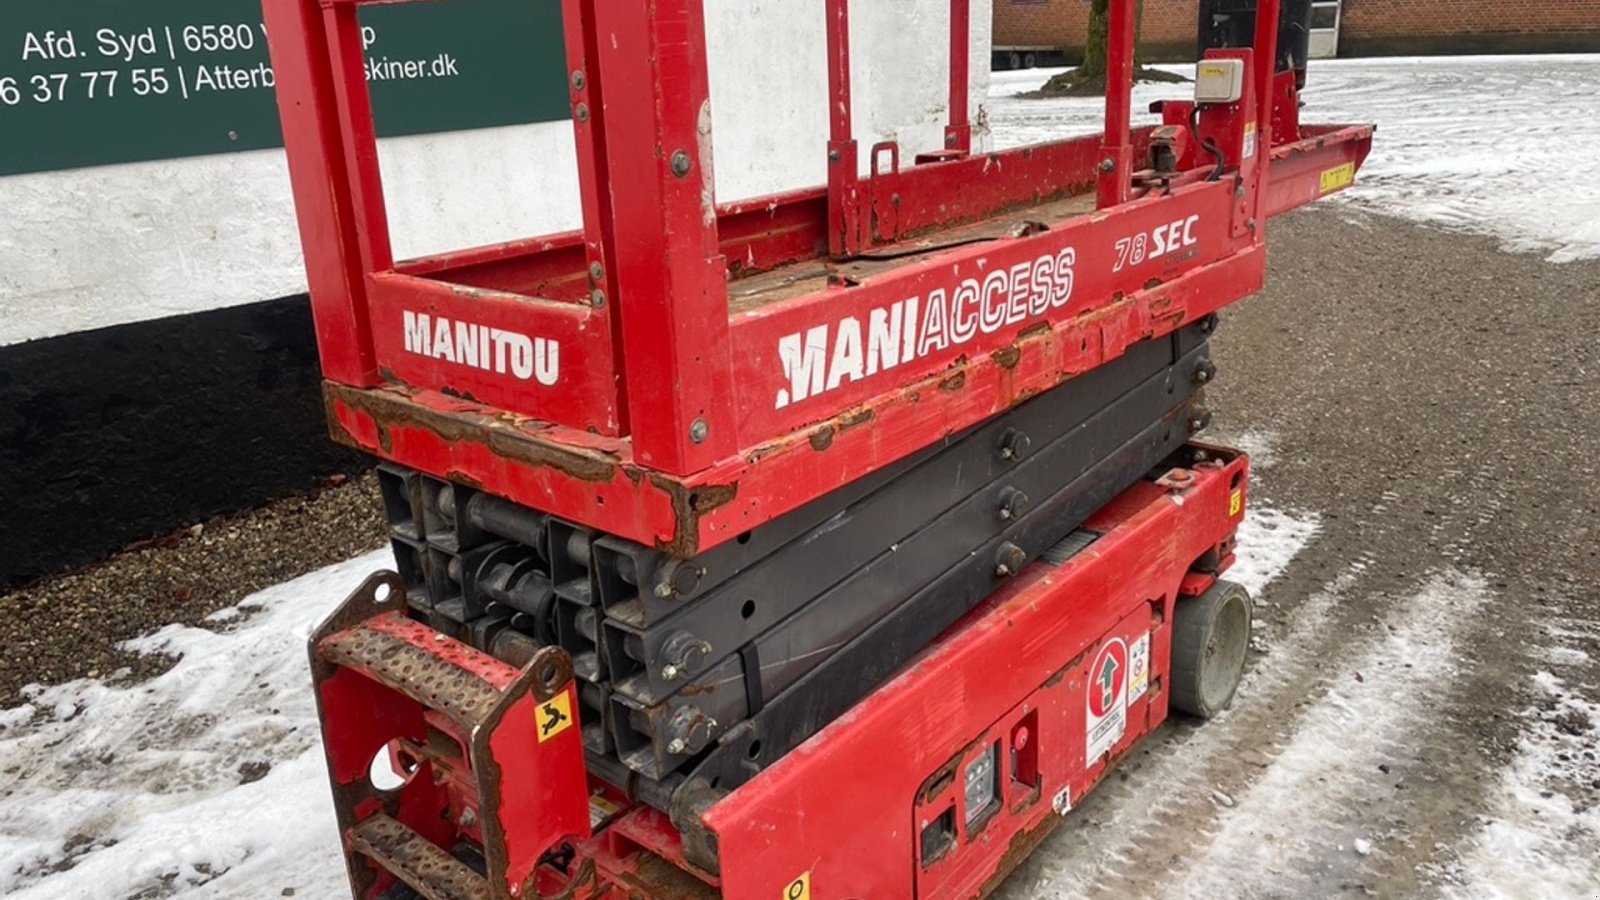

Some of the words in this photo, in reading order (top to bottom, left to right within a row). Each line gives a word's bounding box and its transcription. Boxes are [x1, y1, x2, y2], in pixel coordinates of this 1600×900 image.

[22, 30, 87, 61] Afd.
[96, 27, 157, 62] Syd
[183, 24, 254, 52] 6580
[0, 76, 21, 105] 6
[30, 73, 69, 103] 37
[80, 70, 118, 99] 77
[131, 67, 169, 96] 55
[1112, 231, 1148, 273] 78
[1148, 214, 1200, 260] SEC
[402, 310, 559, 386] MANITOU
[774, 246, 1076, 411] MANIACCESS
